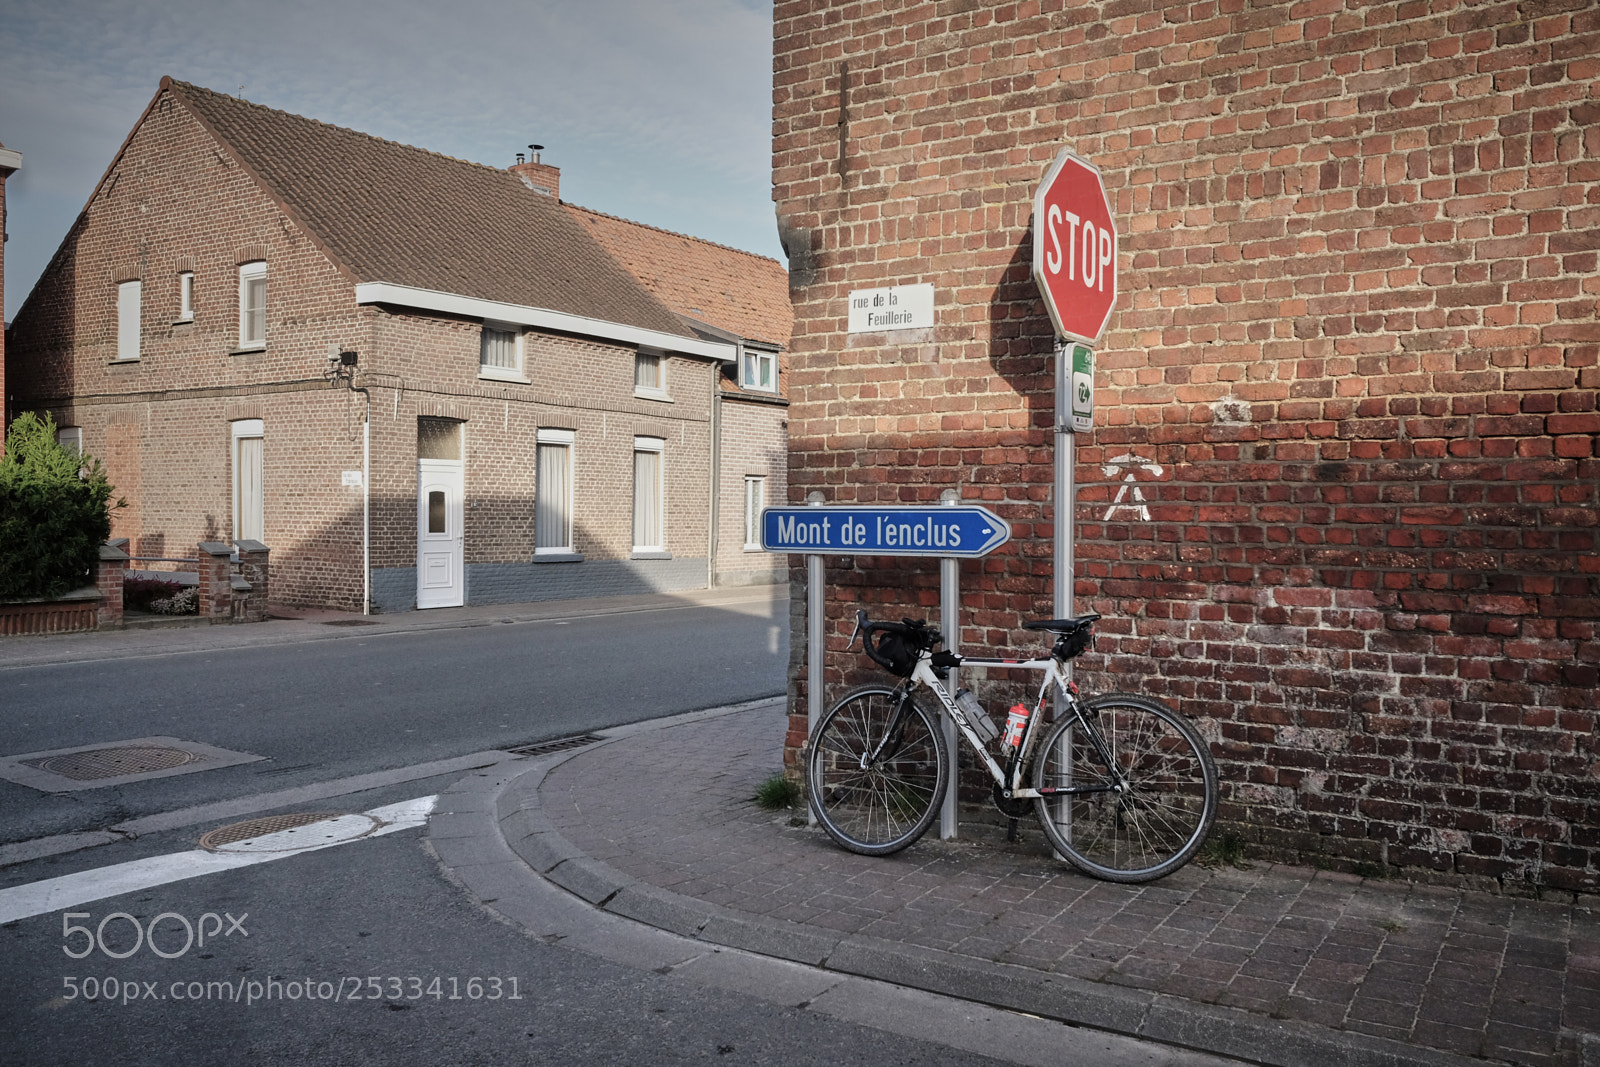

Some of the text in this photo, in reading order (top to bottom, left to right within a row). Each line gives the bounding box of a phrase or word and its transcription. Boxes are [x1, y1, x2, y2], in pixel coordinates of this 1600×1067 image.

[1047, 203, 1112, 293] STOP
[853, 292, 898, 309] rue de la
[868, 310, 912, 327] Feuillerie
[777, 515, 832, 545] Mont
[841, 516, 867, 545] de
